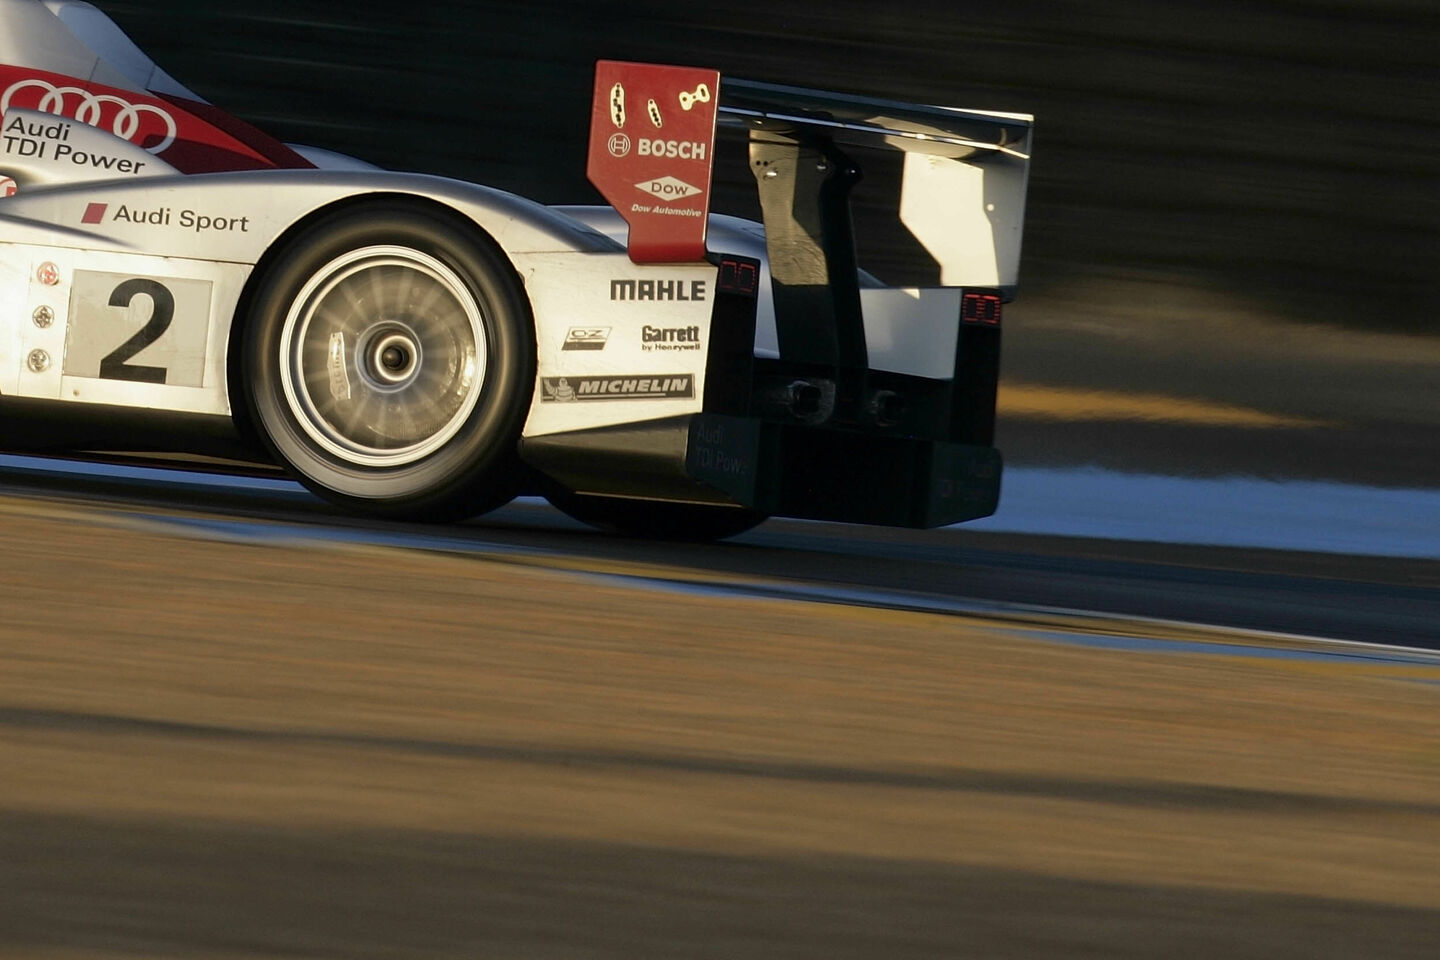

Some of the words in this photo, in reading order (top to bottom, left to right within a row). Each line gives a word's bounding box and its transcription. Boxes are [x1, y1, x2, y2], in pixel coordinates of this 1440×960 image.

[5, 117, 71, 140] Audi
[3, 136, 46, 158] TDI
[54, 144, 146, 174] Power
[638, 138, 706, 160] BOSCH
[113, 205, 170, 225] Audi
[179, 210, 249, 232] Sport
[632, 204, 651, 213] Dow
[652, 206, 702, 217] Automotive
[610, 279, 705, 301] MAHLE
[99, 278, 175, 385] 2
[642, 325, 700, 342] Garrett
[642, 343, 652, 352] by
[578, 378, 688, 393] MICHELIN
